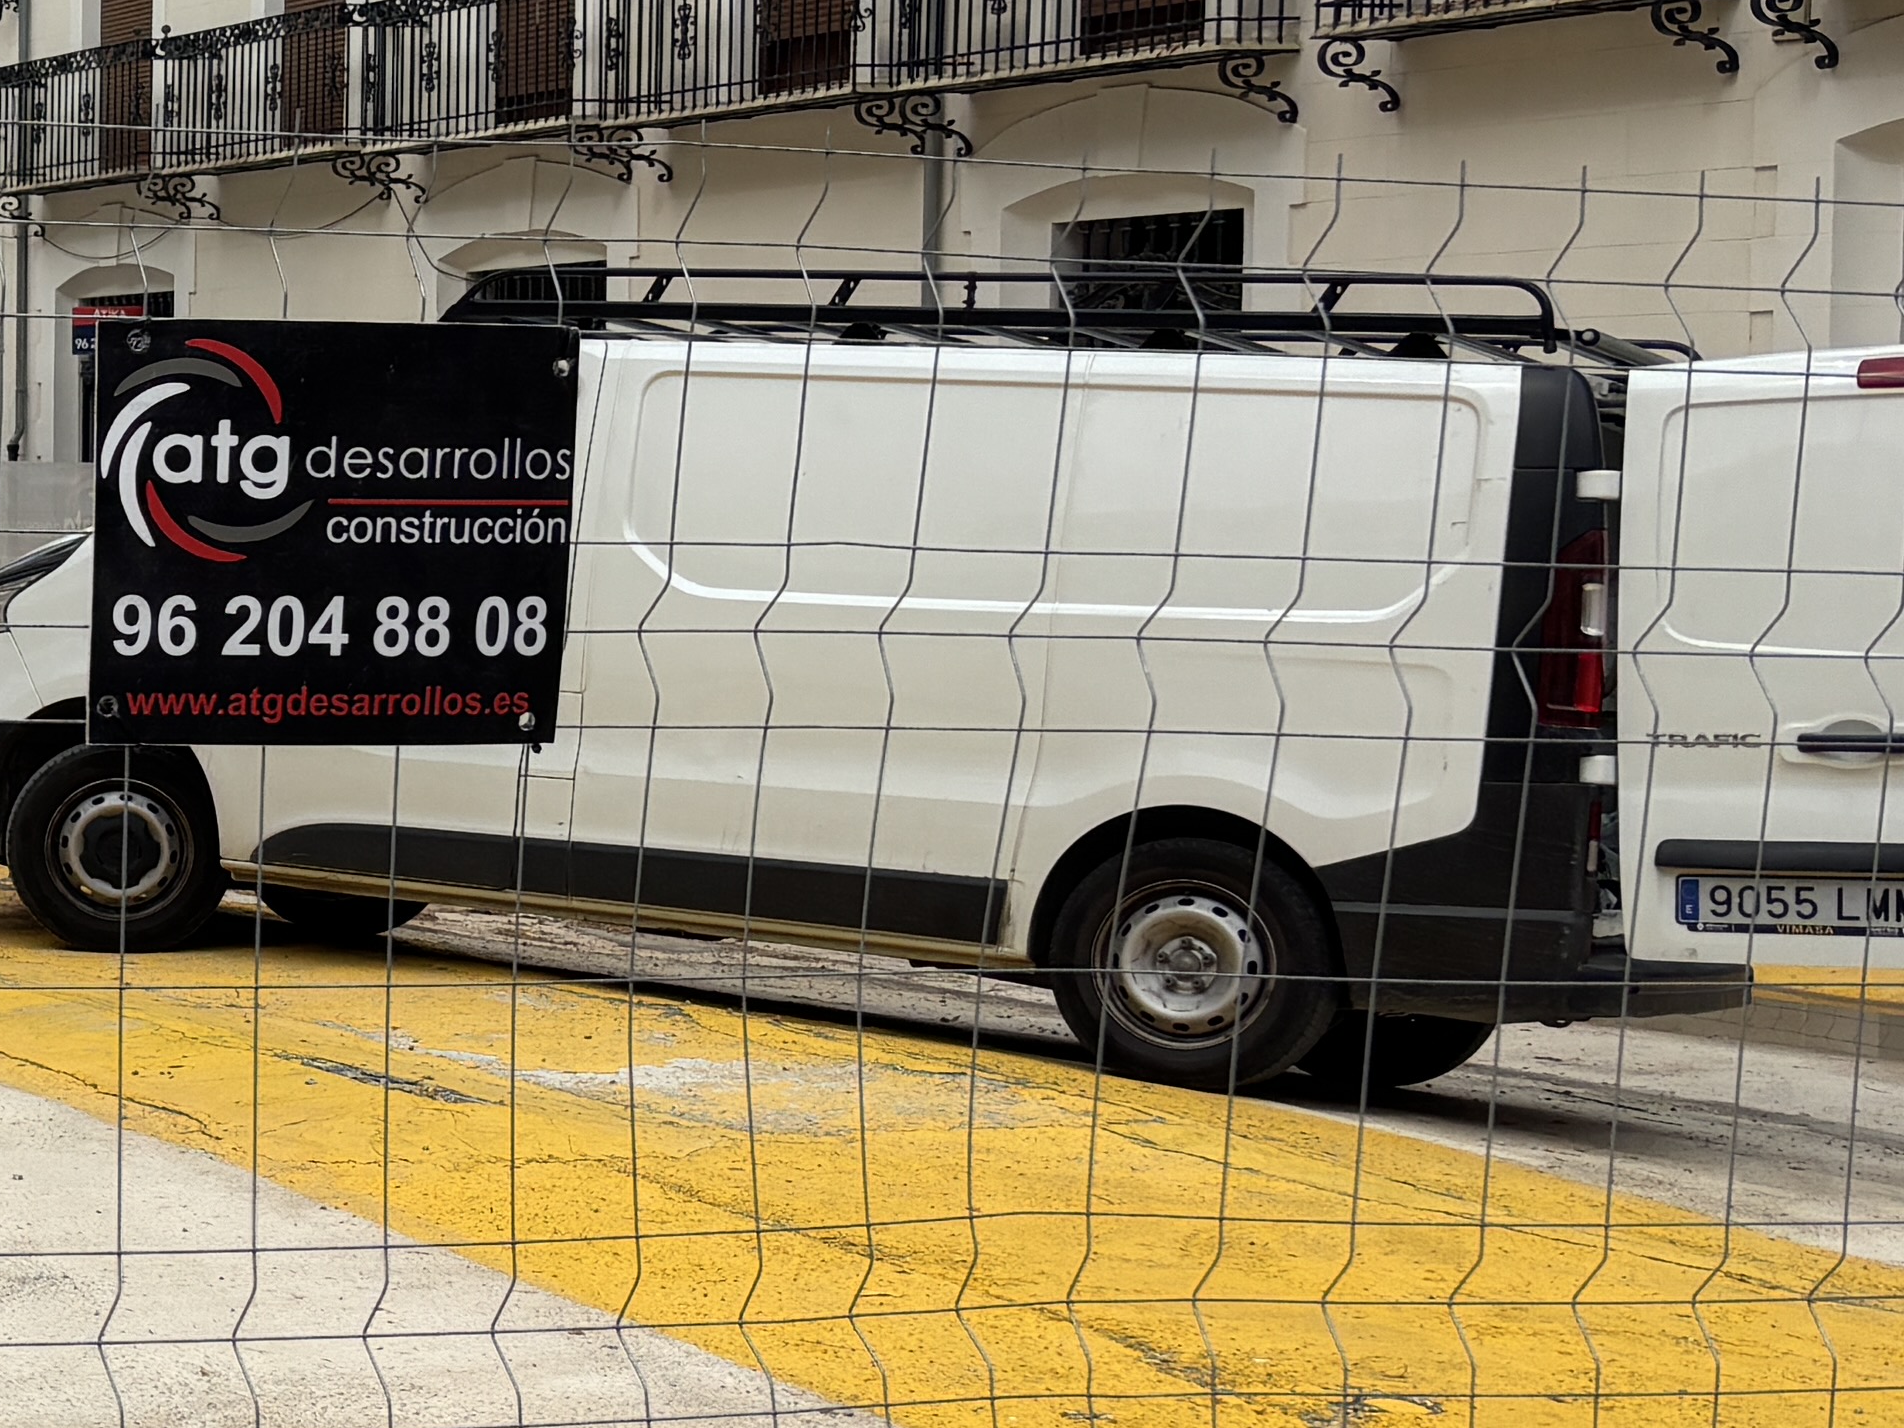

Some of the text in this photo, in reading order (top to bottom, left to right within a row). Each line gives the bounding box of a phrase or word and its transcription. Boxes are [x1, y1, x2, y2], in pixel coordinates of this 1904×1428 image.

[74, 337, 89, 350] 96
[152, 418, 572, 500] atg desarrollos
[326, 508, 567, 544] construcción
[112, 594, 548, 658] 96 204 88 08
[126, 684, 530, 724] www.atgdesarrollos.es
[1645, 732, 1762, 749] TRAFIC
[1685, 904, 1694, 915] E
[1709, 884, 1819, 920] 9055
[1776, 924, 1835, 936] VIMASA
